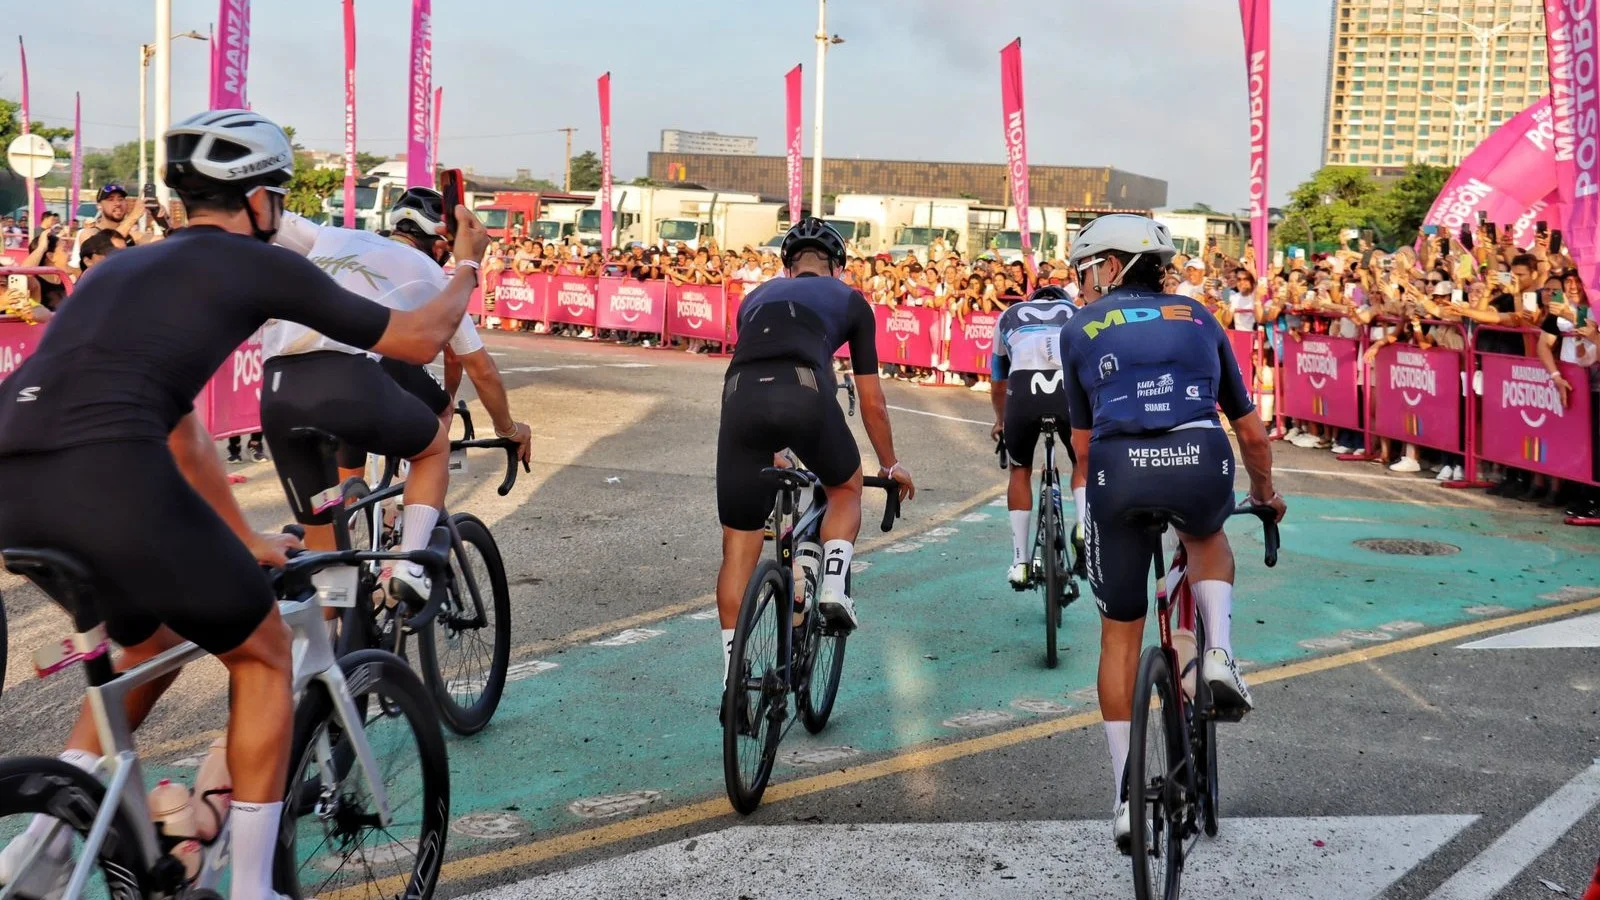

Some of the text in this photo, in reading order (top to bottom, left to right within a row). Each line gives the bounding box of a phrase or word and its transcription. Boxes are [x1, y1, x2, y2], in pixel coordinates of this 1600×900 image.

[1297, 352, 1337, 380] POSTOBÓN
[1390, 363, 1436, 396] POSTOBÓN
[1144, 403, 1170, 412] SUAREZ
[1502, 379, 1564, 417] POSTOBÓN
[1128, 443, 1200, 458] MEDELLÍN
[1131, 455, 1199, 467] TE QUIERE
